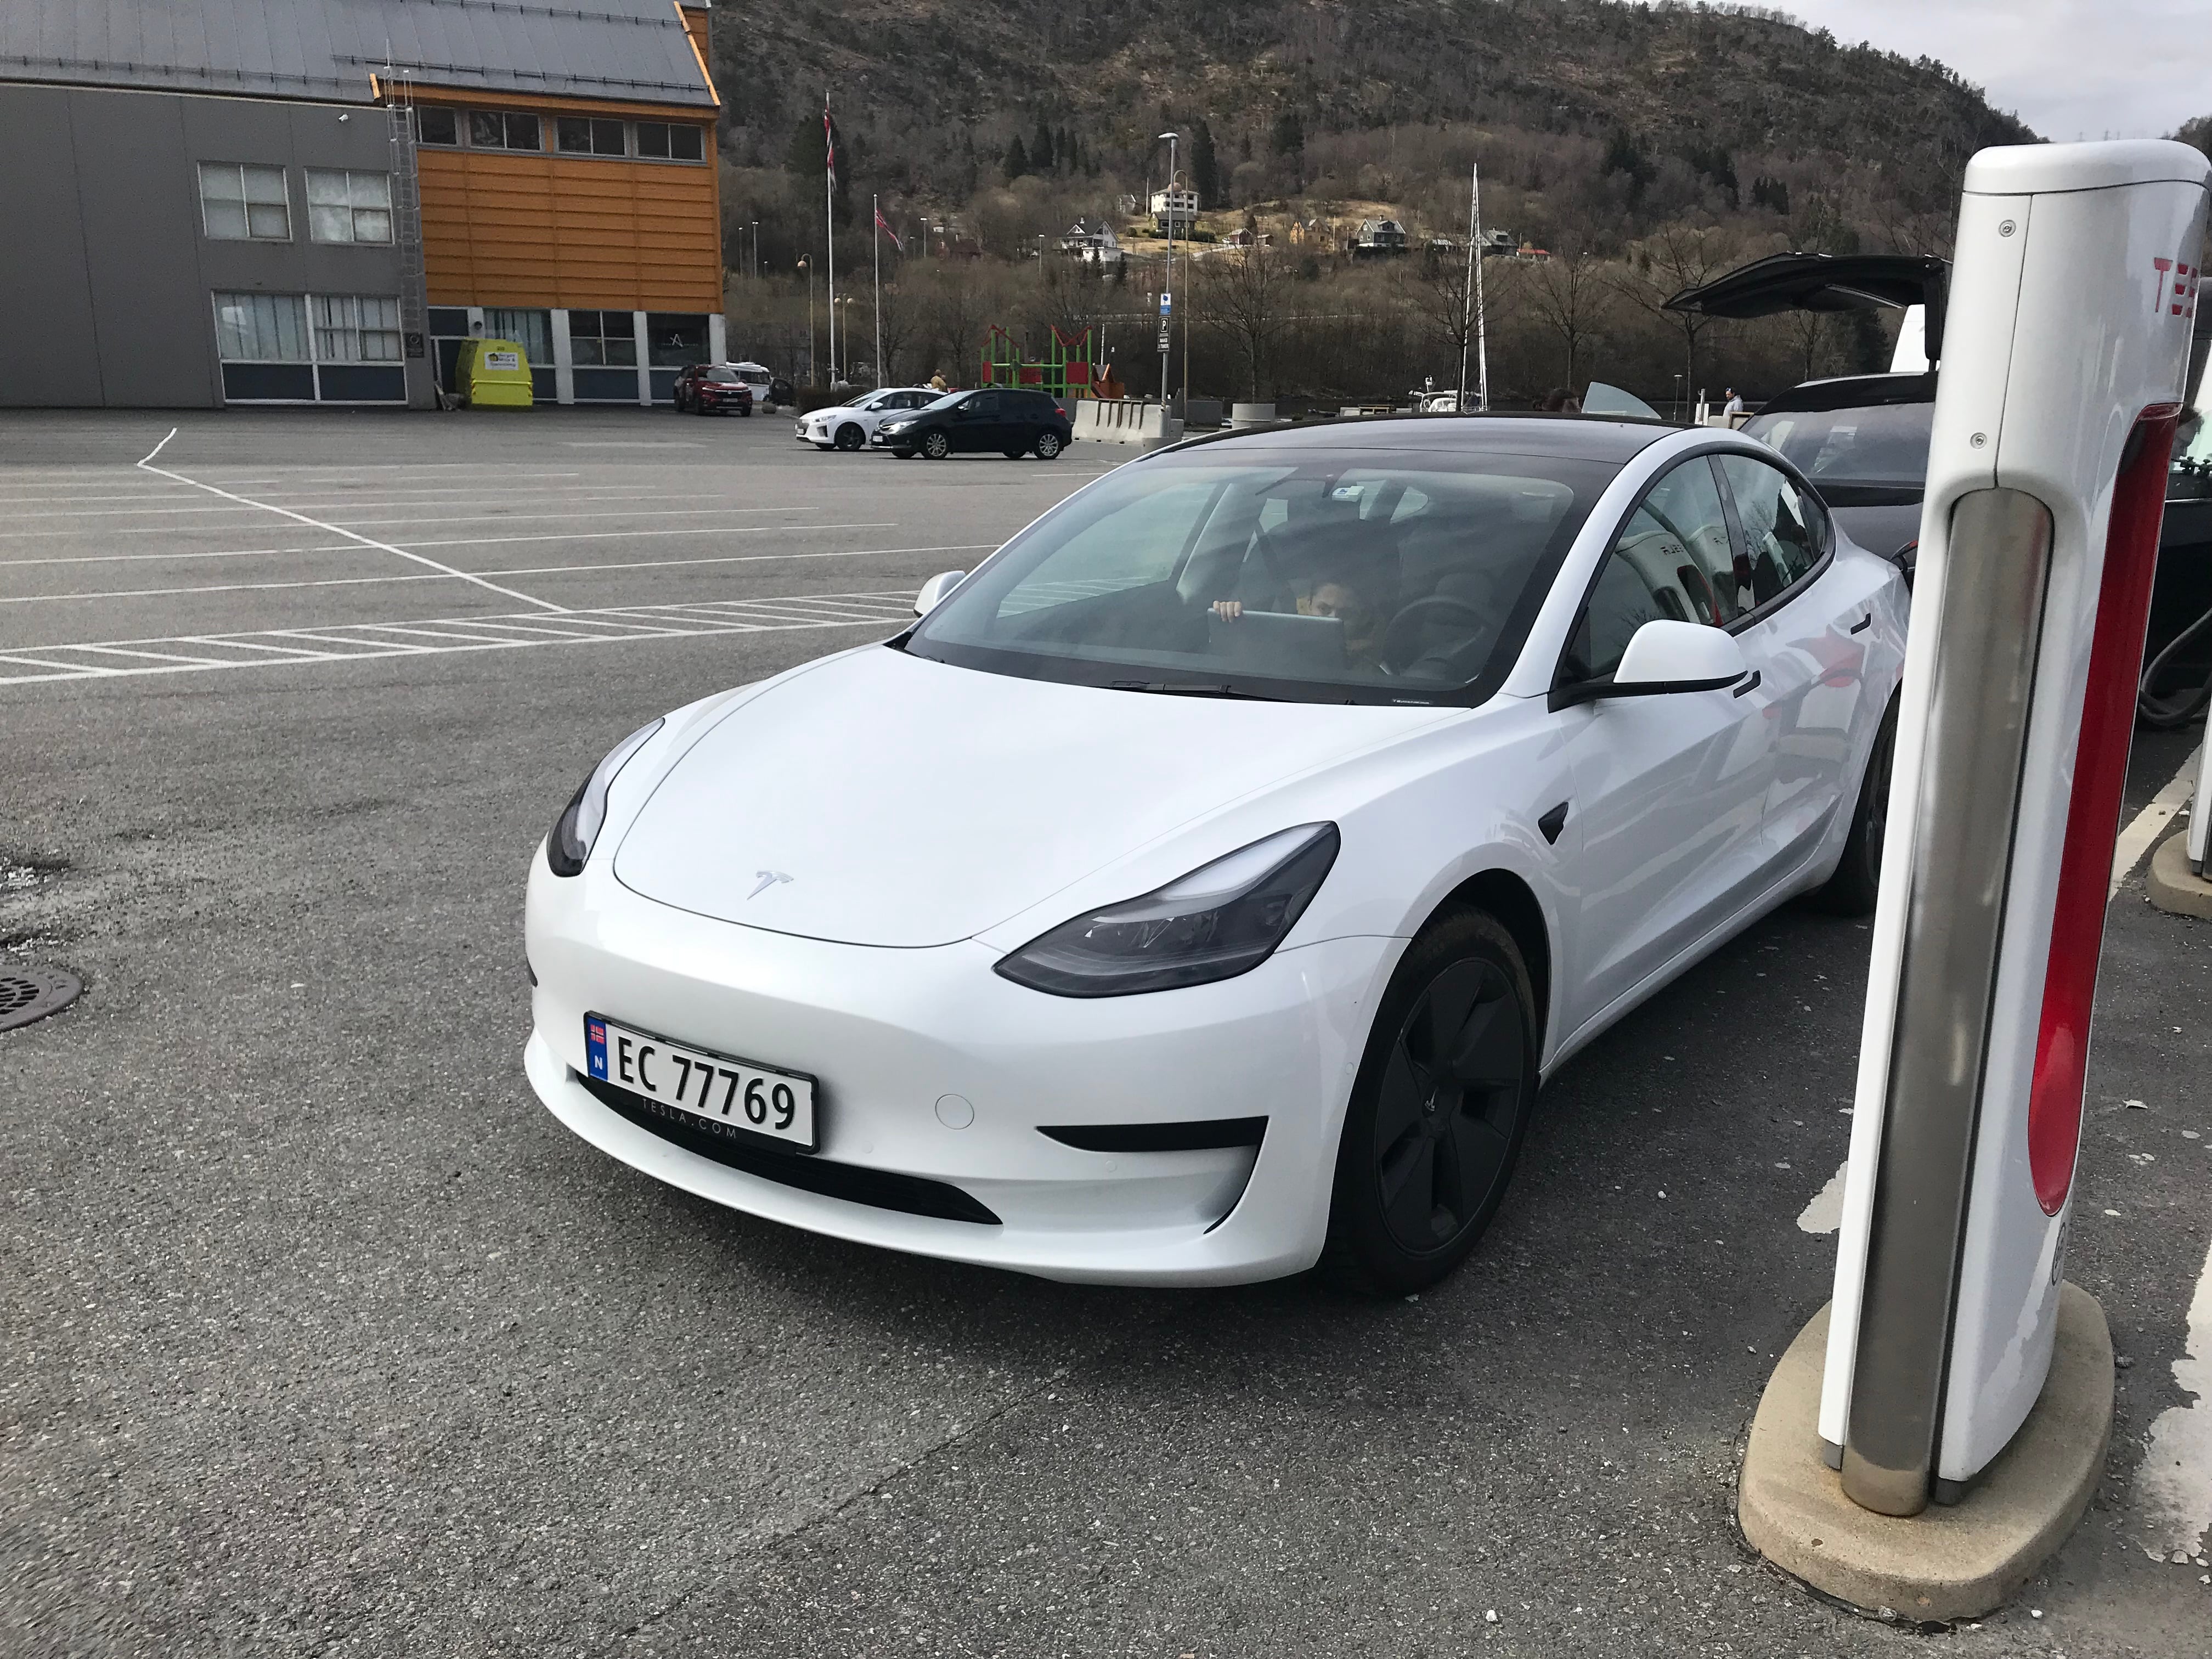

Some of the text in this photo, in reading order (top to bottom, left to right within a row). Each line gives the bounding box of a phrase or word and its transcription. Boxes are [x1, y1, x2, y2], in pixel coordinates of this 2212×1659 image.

[1162, 320, 1166, 330] P
[595, 1055, 603, 1070] N
[618, 1036, 795, 1130] EC 77769
[642, 1099, 737, 1139] TESLA.COM
